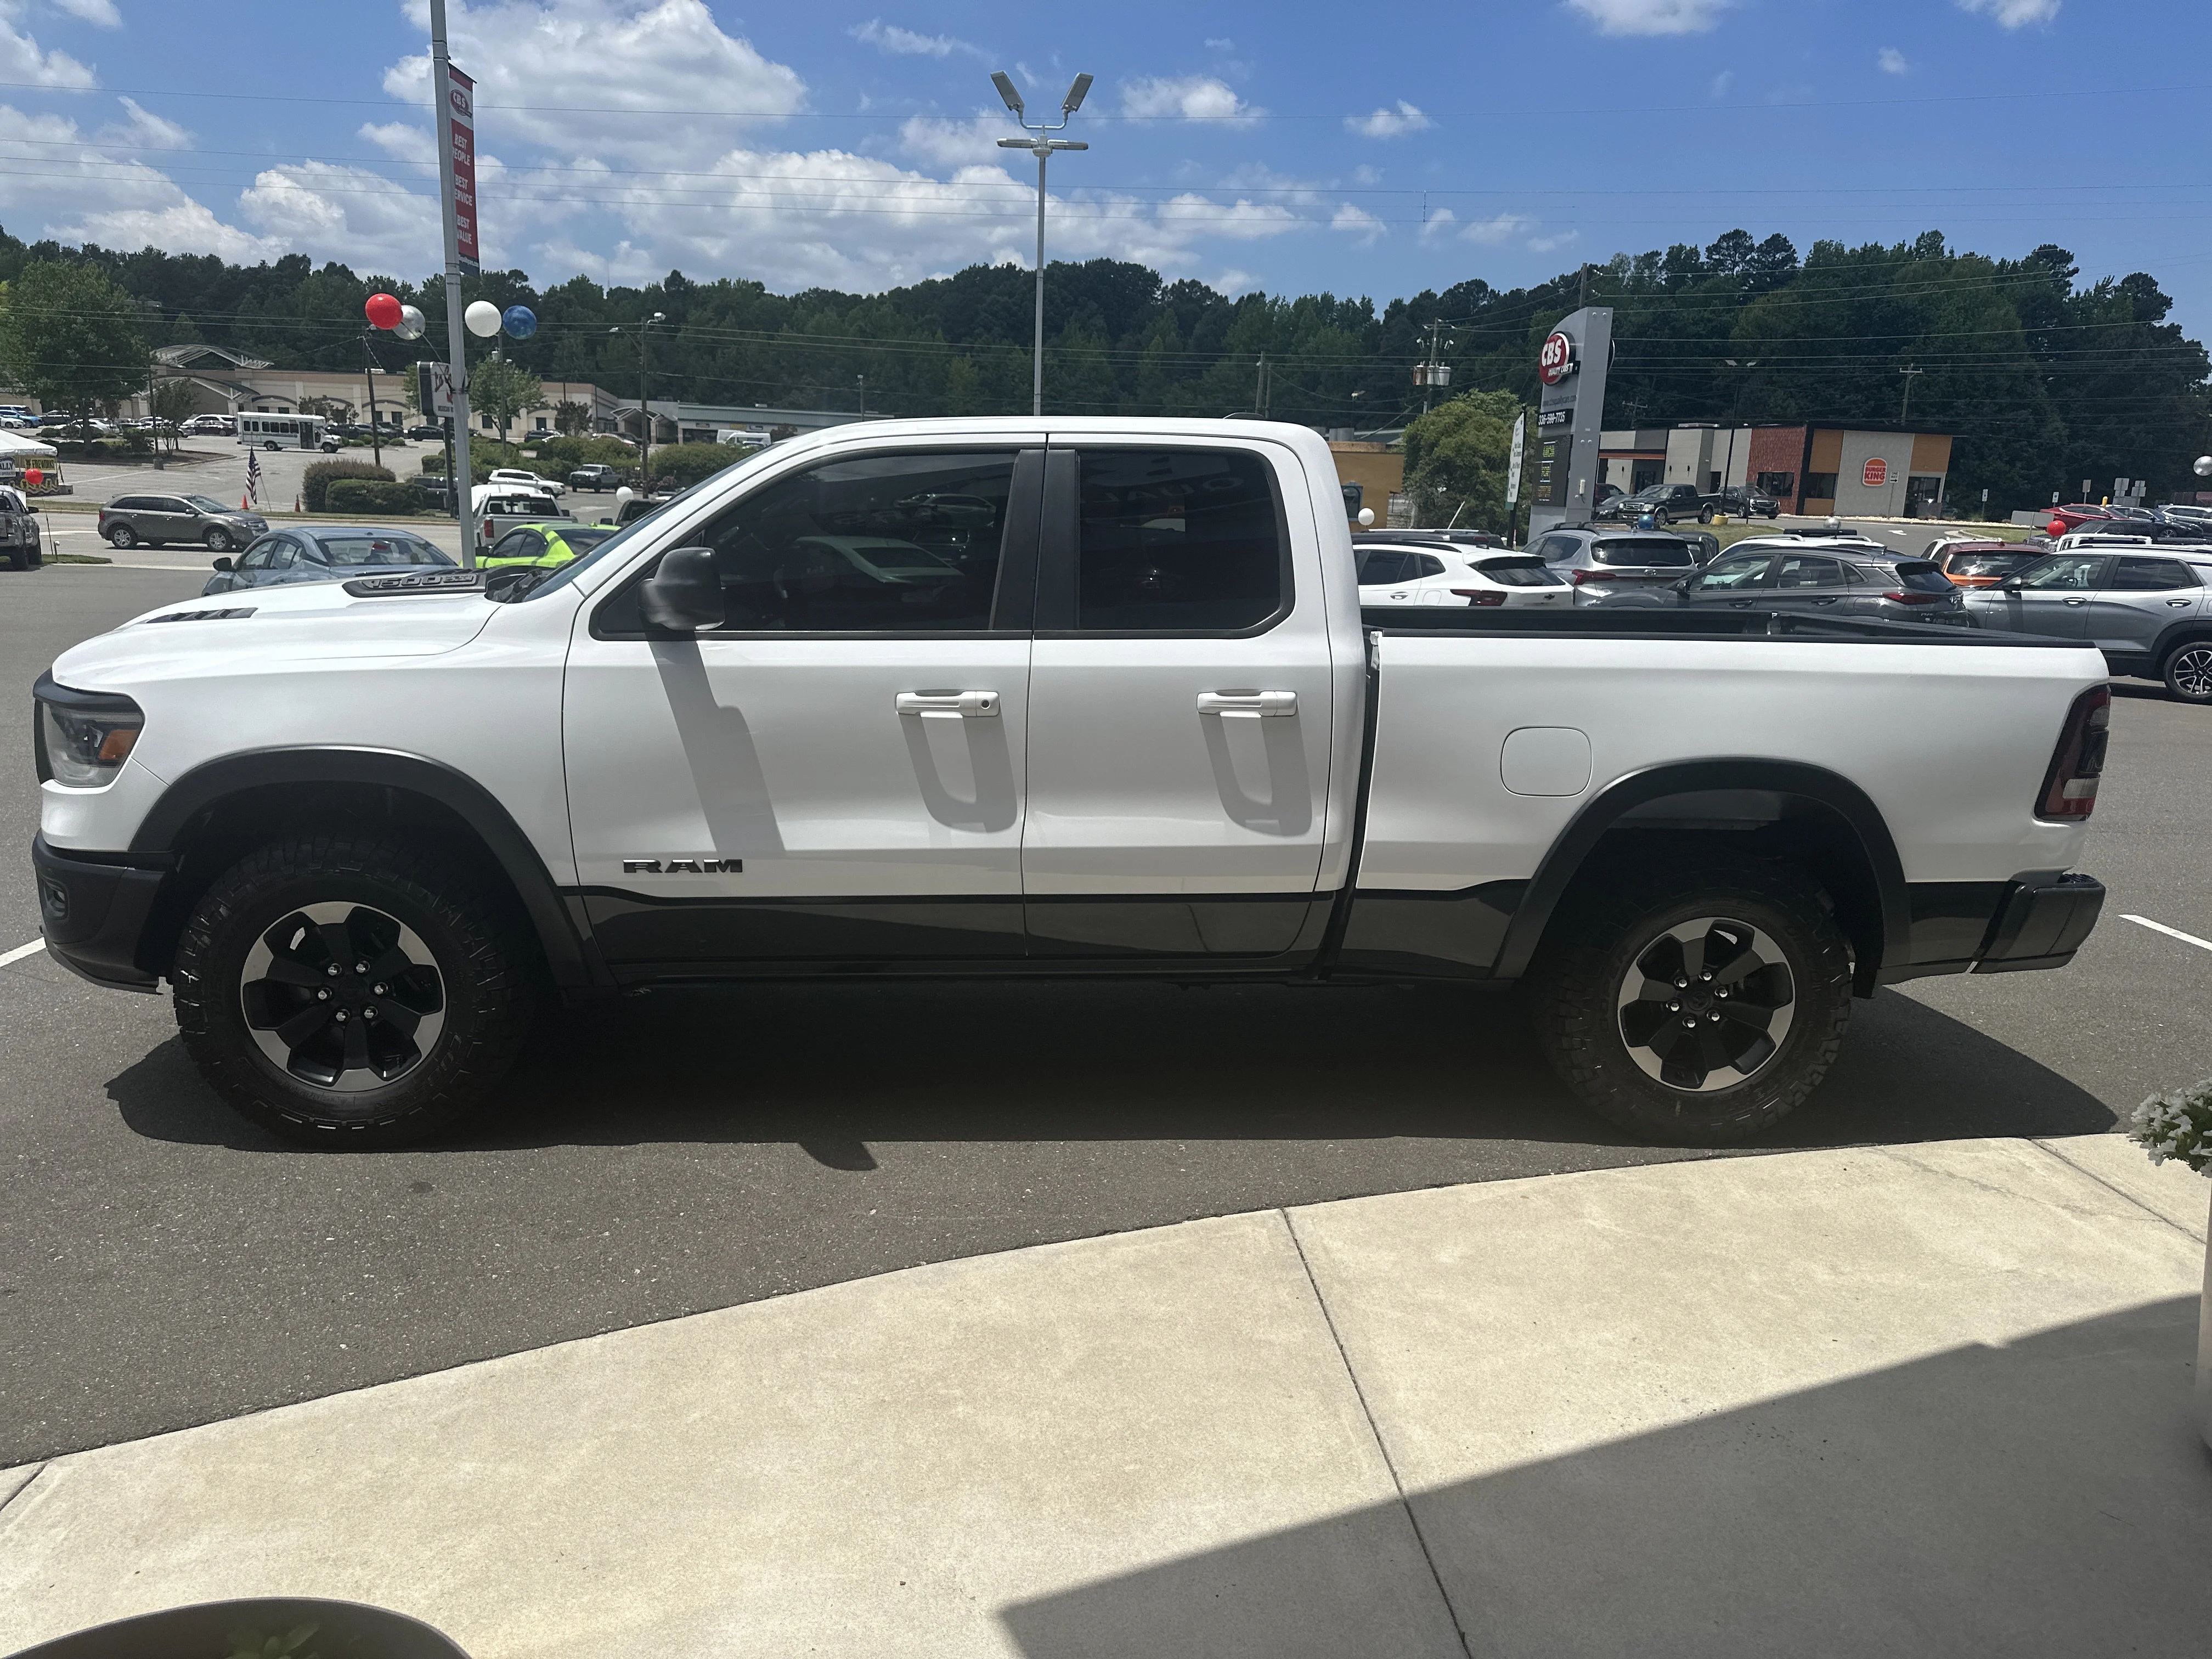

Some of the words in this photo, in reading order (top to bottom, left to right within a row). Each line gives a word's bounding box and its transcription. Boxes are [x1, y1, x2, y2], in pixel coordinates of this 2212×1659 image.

[453, 92, 466, 108] CBS
[454, 133, 467, 150] BEST
[455, 174, 468, 190] BEST
[455, 188, 472, 206] ERVICE
[457, 215, 470, 229] BEST
[1542, 339, 1562, 366] CBS
[623, 859, 743, 873] RAM
